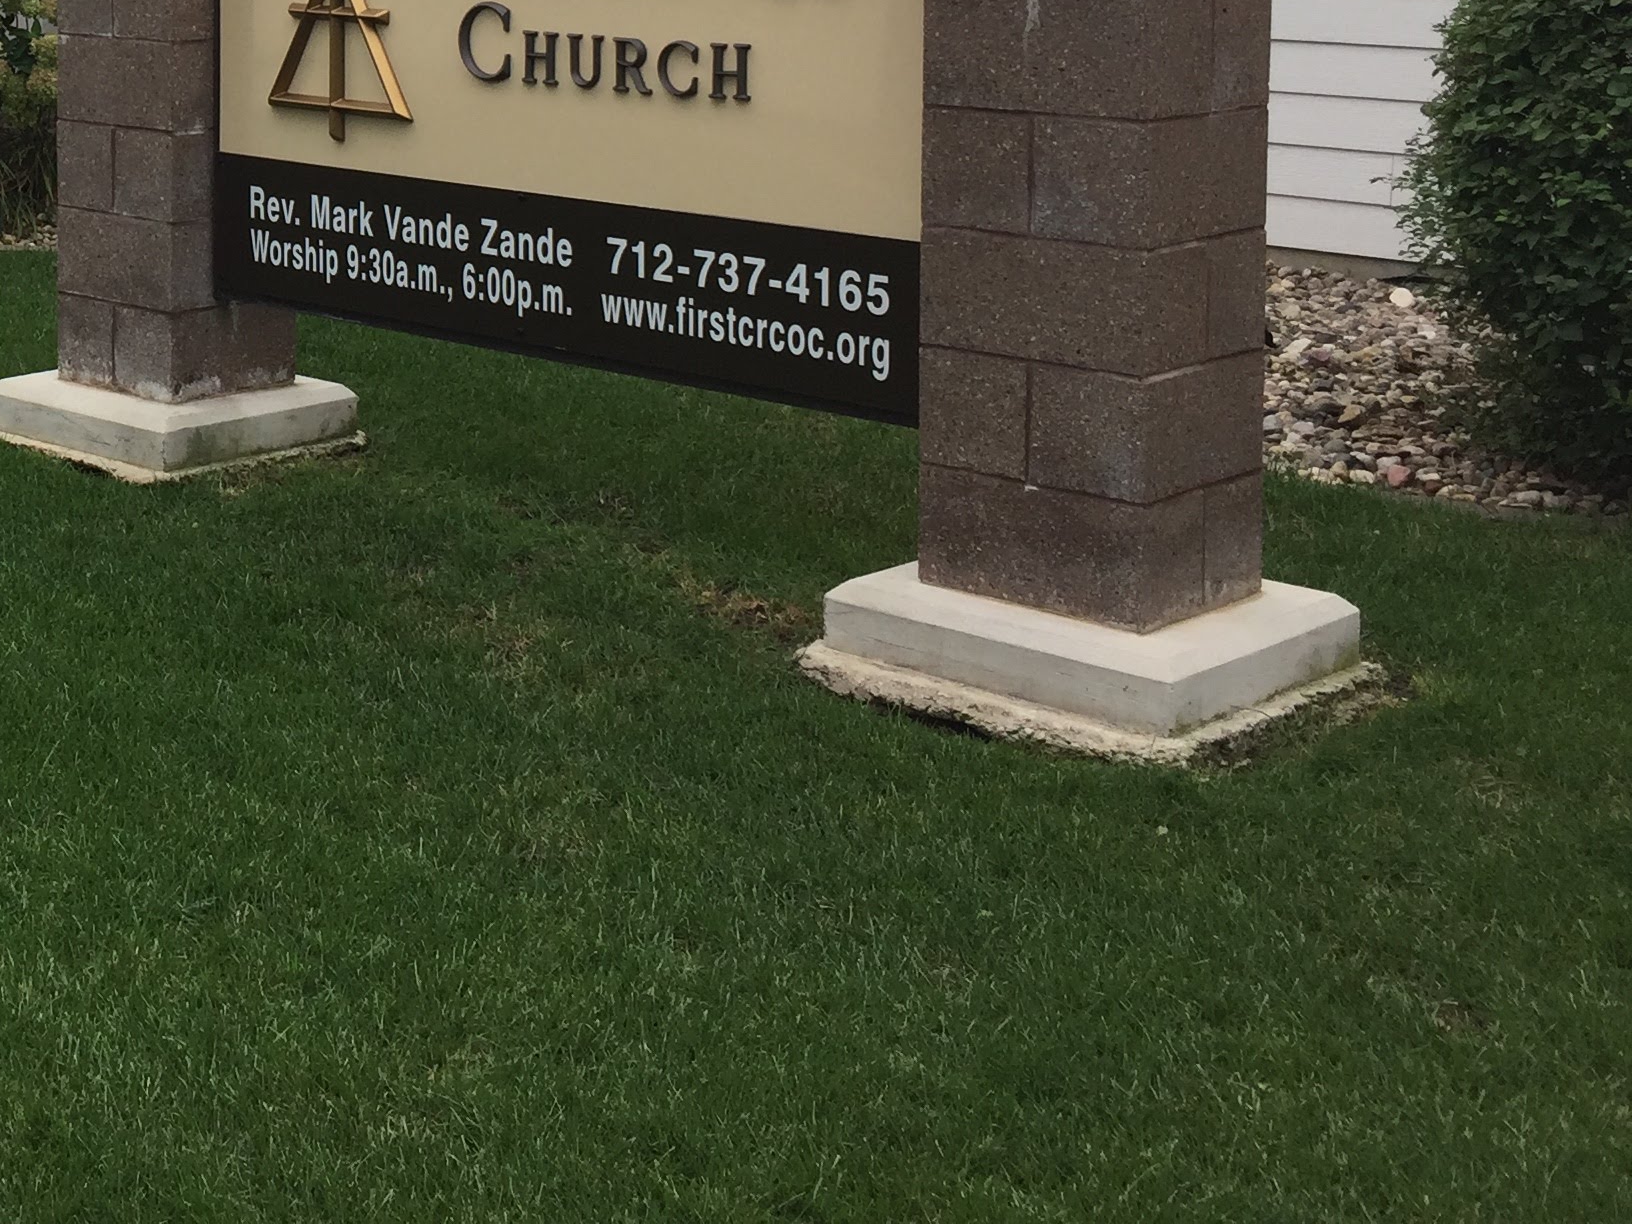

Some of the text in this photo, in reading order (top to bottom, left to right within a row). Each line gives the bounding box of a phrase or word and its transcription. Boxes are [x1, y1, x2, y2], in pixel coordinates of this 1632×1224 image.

[458, 1, 753, 102] CHURCH
[249, 184, 574, 269] Rev. Mark Vande Zande
[250, 228, 339, 284] Worship
[462, 262, 573, 318] 6:00p.m.
[605, 236, 891, 317] 712-737-4165
[600, 289, 891, 382] www.firstcrcoc.org
